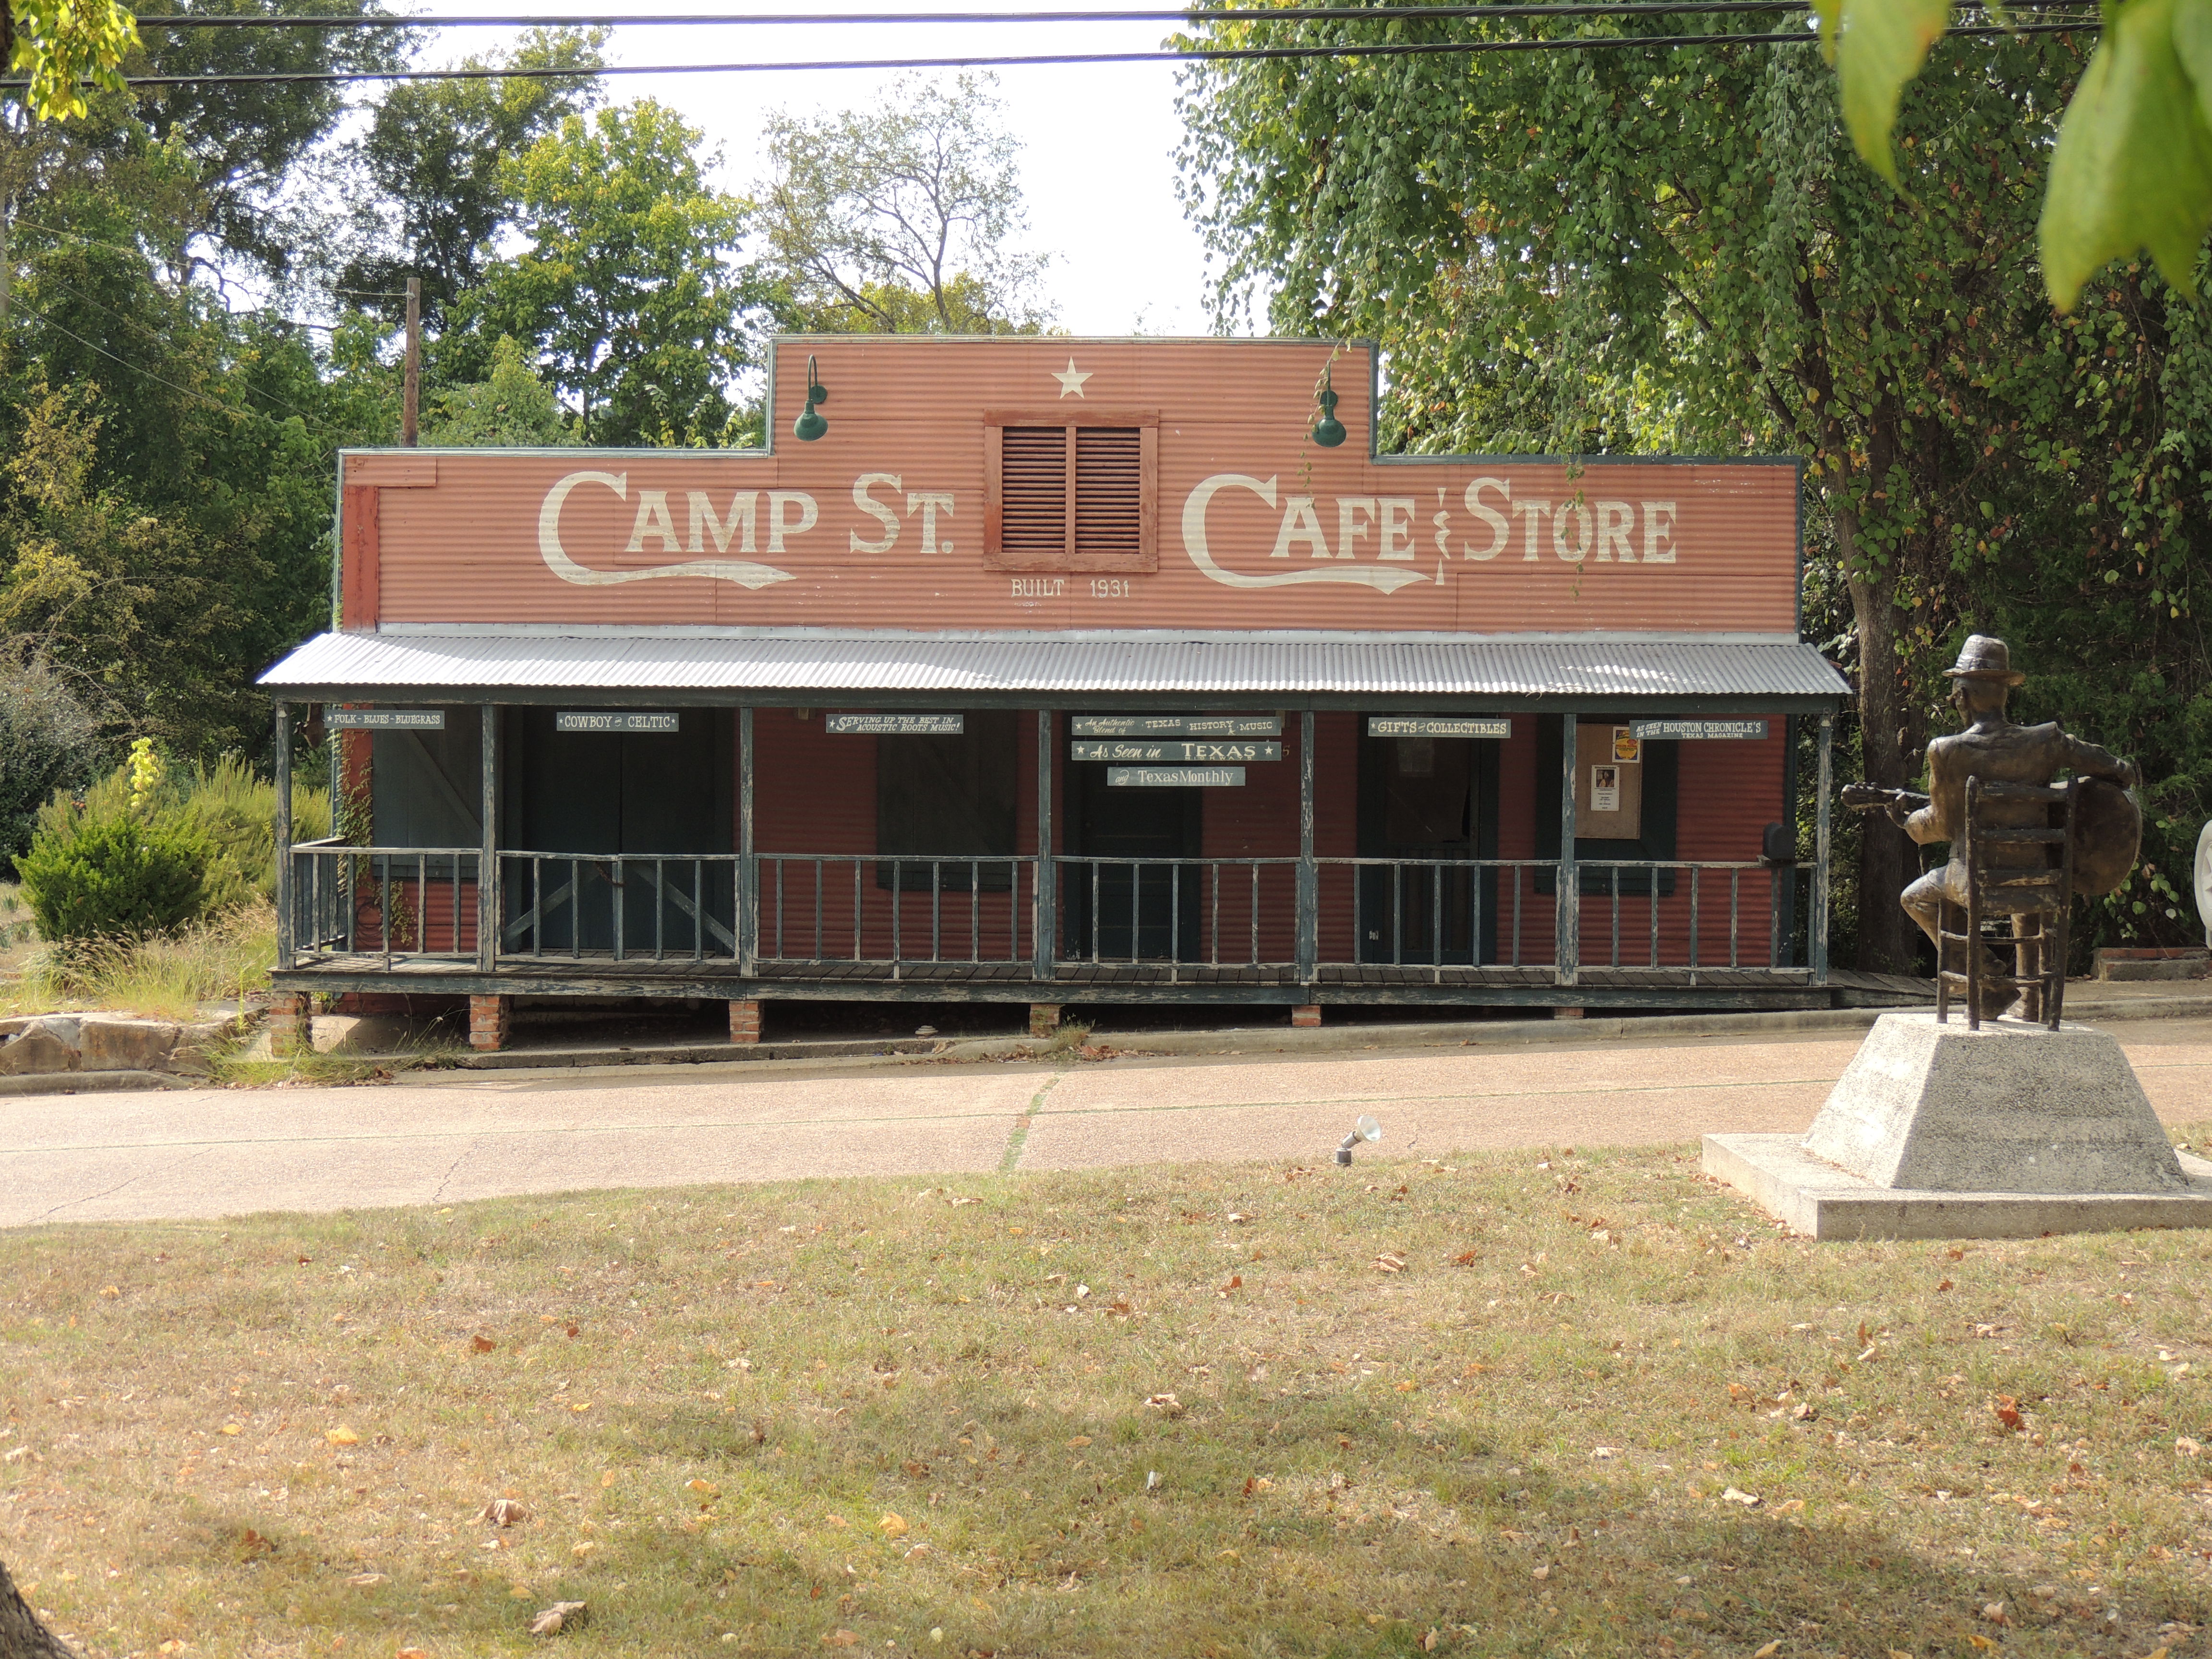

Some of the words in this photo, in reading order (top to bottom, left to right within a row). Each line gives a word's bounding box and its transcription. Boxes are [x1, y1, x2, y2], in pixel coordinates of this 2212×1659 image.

[539, 471, 818, 590] CAMP
[850, 472, 954, 553] ST.
[1182, 474, 1432, 595] CAFE
[1464, 477, 1676, 564] STORE
[1010, 578, 1064, 598] BUILT
[1090, 579, 1130, 598] 1931
[334, 714, 357, 723] FOLK
[364, 714, 389, 724] BLUES
[396, 715, 440, 724] BLUEGRASS
[565, 715, 613, 728] COWBOY
[628, 716, 670, 728] CELTIC
[836, 716, 881, 731] SERVING
[1098, 718, 1135, 726] Authentic
[1145, 719, 1181, 728] TEXAS
[1189, 721, 1234, 731] HISTORY
[1239, 721, 1273, 731] MUSIC
[1645, 721, 1662, 730] SEEN
[930, 722, 960, 732] MUSIC!
[1093, 725, 1116, 733] Blend
[1118, 726, 1126, 734] of
[1377, 721, 1417, 733] GIFTS
[1426, 721, 1507, 734] COLLECTIBLES
[1663, 722, 1702, 733] HOUSTON
[1704, 721, 1761, 733] CHRONICLE'S
[1090, 745, 1108, 758] As
[1112, 745, 1142, 758] Seen
[1146, 745, 1161, 758] in
[1181, 743, 1256, 757] TEXAS
[1115, 769, 1130, 785] and
